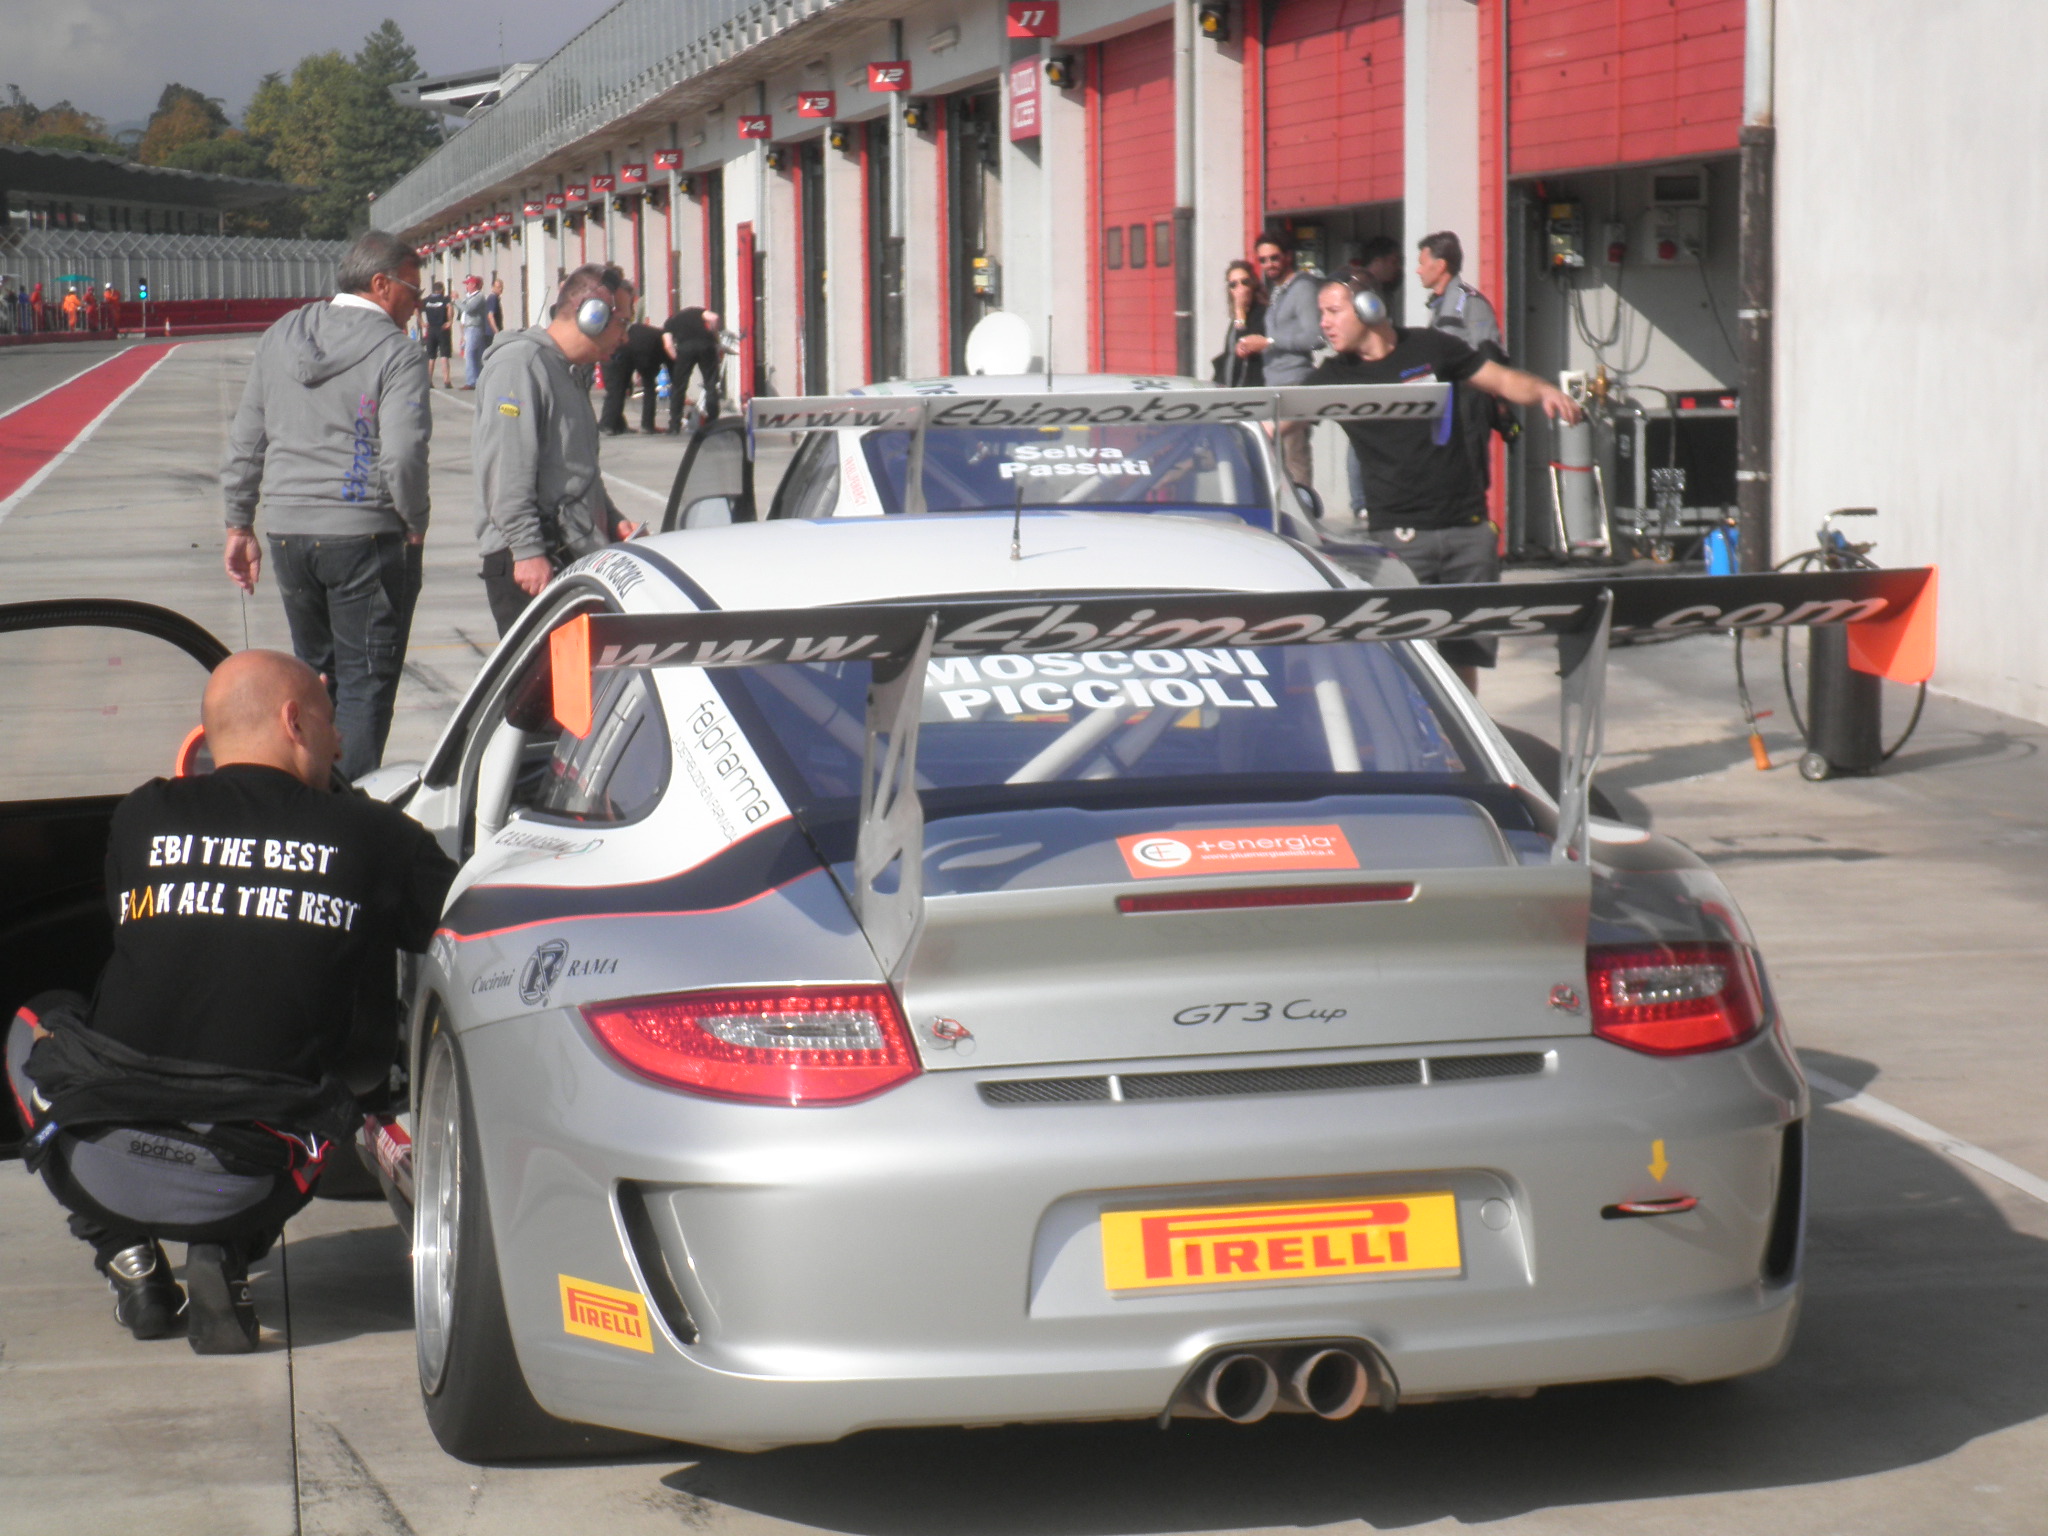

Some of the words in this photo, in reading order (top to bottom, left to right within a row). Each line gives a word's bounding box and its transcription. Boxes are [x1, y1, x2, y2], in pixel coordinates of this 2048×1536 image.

[1018, 11, 1044, 26] 11
[874, 68, 904, 83] 12
[802, 97, 830, 110] 13
[741, 120, 766, 132] 14
[658, 152, 681, 163] 15
[594, 178, 612, 188] 17
[758, 412, 905, 427] www.
[932, 399, 1267, 425] Ebimotors
[1012, 445, 1123, 461] Selva
[999, 461, 1151, 479] Passuti
[596, 635, 892, 668] www.
[933, 597, 1582, 653] Ebimotors
[924, 649, 1270, 687] MOSCONI
[939, 678, 1278, 719] PICCIOLI
[686, 700, 770, 824] felpharma
[149, 834, 193, 867] EBI
[202, 836, 256, 868] THE
[263, 839, 338, 874] BEST
[177, 881, 225, 915] ALL
[237, 886, 293, 919] THE
[298, 891, 361, 931] REST
[567, 959, 619, 977] RAMA
[1282, 999, 1348, 1023] Cup
[130, 1139, 198, 1163] sparco
[1141, 1202, 1410, 1279] PIRELLI
[567, 1286, 642, 1338] PIRELLI
